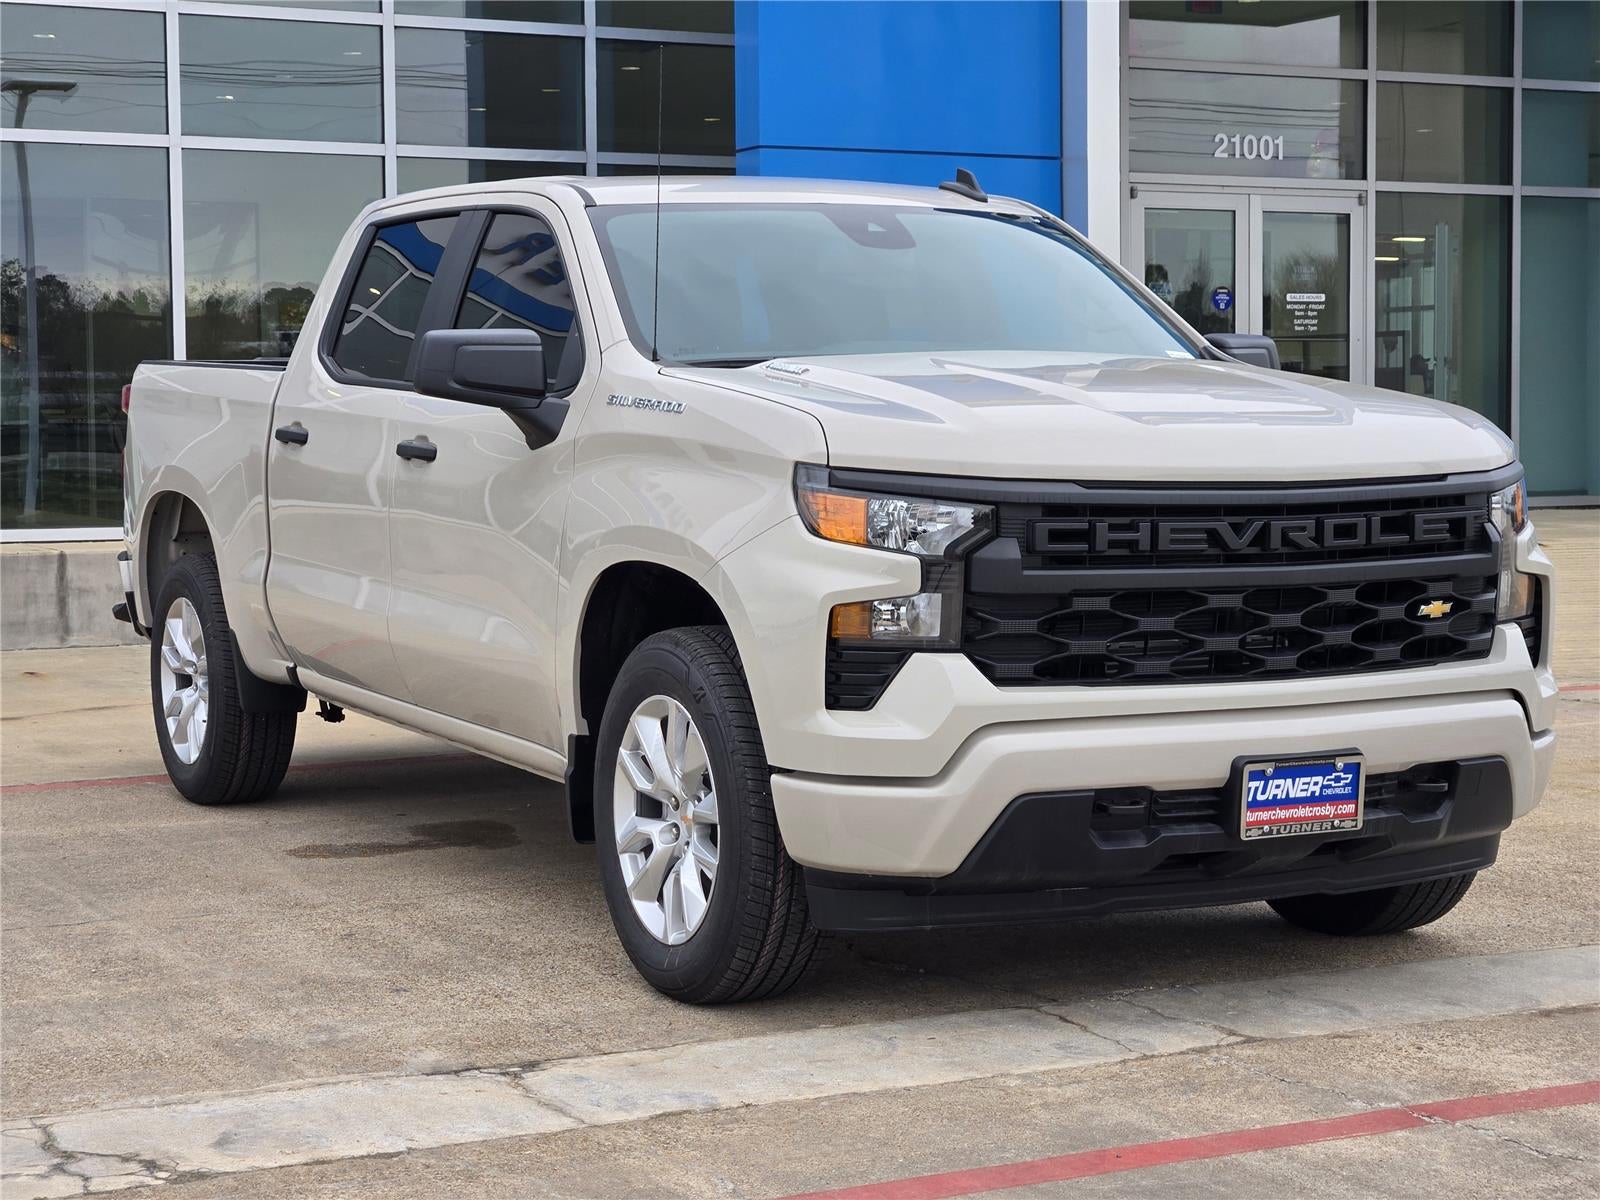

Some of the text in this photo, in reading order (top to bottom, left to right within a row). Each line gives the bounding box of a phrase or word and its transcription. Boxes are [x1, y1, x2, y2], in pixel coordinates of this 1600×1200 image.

[1214, 133, 1284, 160] 21001
[607, 393, 687, 414] SILVERADO
[1031, 511, 1488, 553] CHEVROLET
[1247, 776, 1323, 802] TURNER
[1323, 786, 1352, 795] CHEVROLET
[1246, 803, 1355, 821] turnerchevroletcrosby.com
[1271, 822, 1332, 835] TURNER
